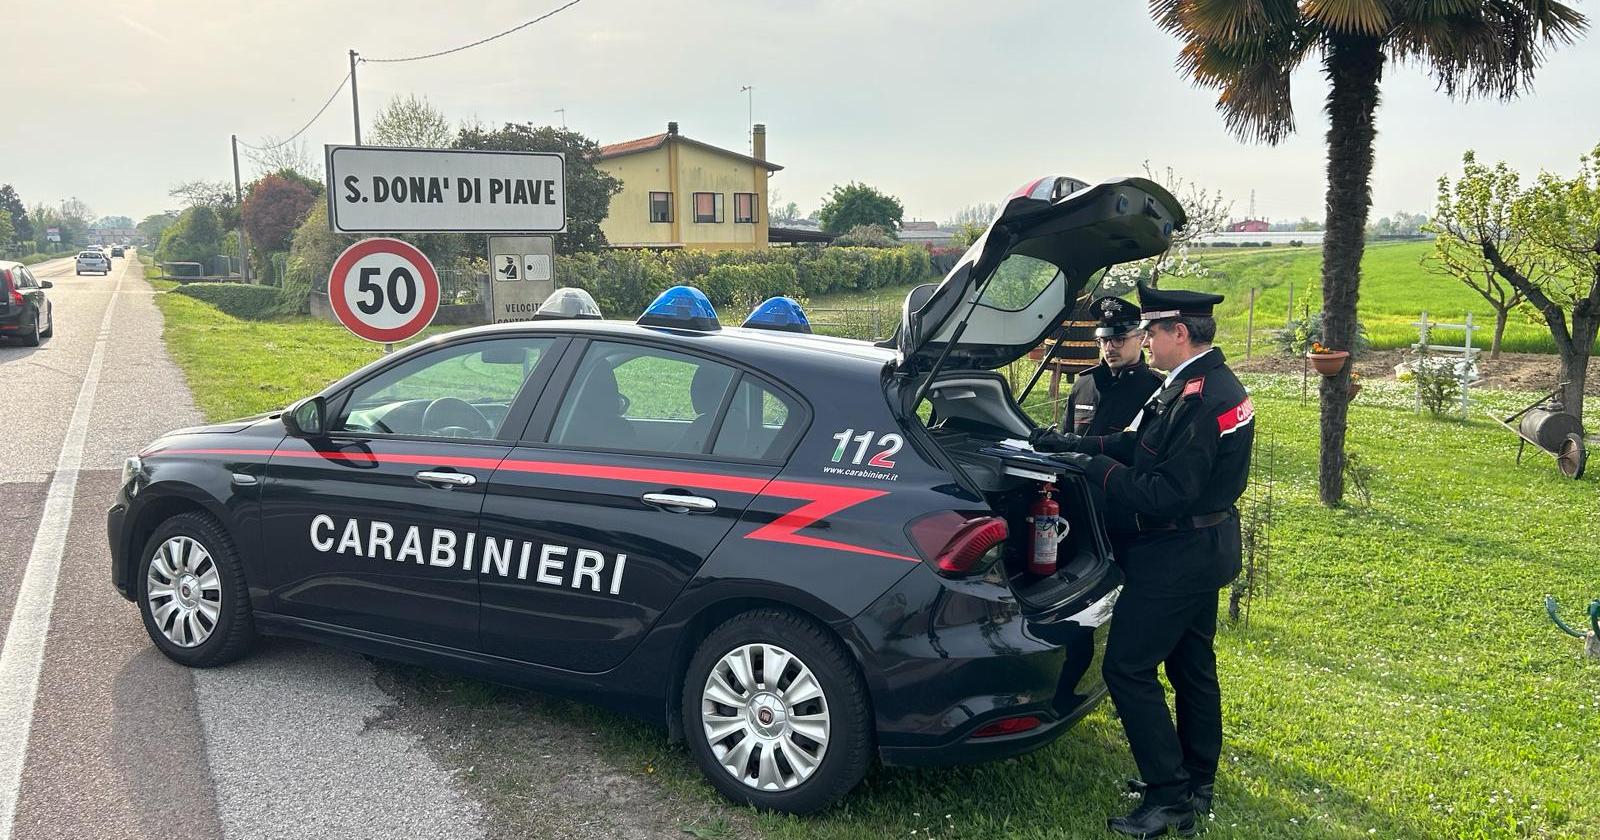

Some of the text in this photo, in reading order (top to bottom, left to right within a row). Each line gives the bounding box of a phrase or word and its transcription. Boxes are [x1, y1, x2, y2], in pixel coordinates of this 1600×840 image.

[344, 175, 556, 205] S. DONA' DI PIAVE
[356, 266, 417, 315] 50
[831, 428, 904, 469] 112
[823, 466, 898, 481] www.carabinieri.it
[309, 513, 627, 595] CARABINIERI
